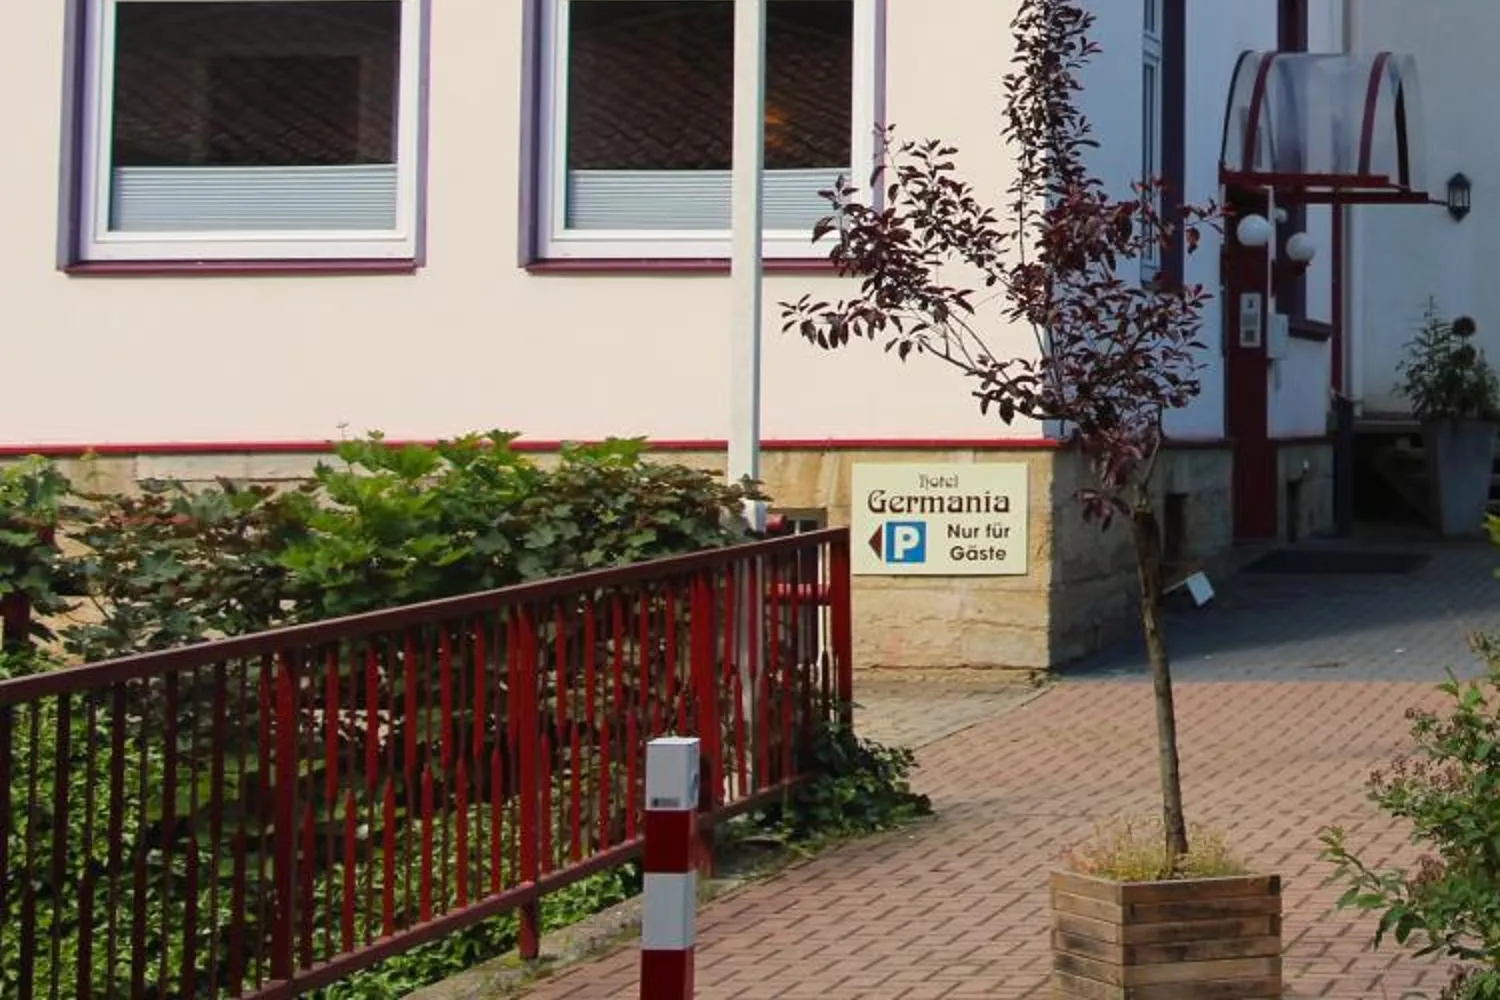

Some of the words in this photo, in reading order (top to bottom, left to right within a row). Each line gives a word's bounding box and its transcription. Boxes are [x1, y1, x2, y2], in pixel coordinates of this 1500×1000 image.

[867, 489, 1010, 514] Germania
[947, 523, 979, 539] Nur
[985, 522, 1010, 539] für
[894, 526, 920, 559] P
[949, 544, 1007, 561] Gäste
